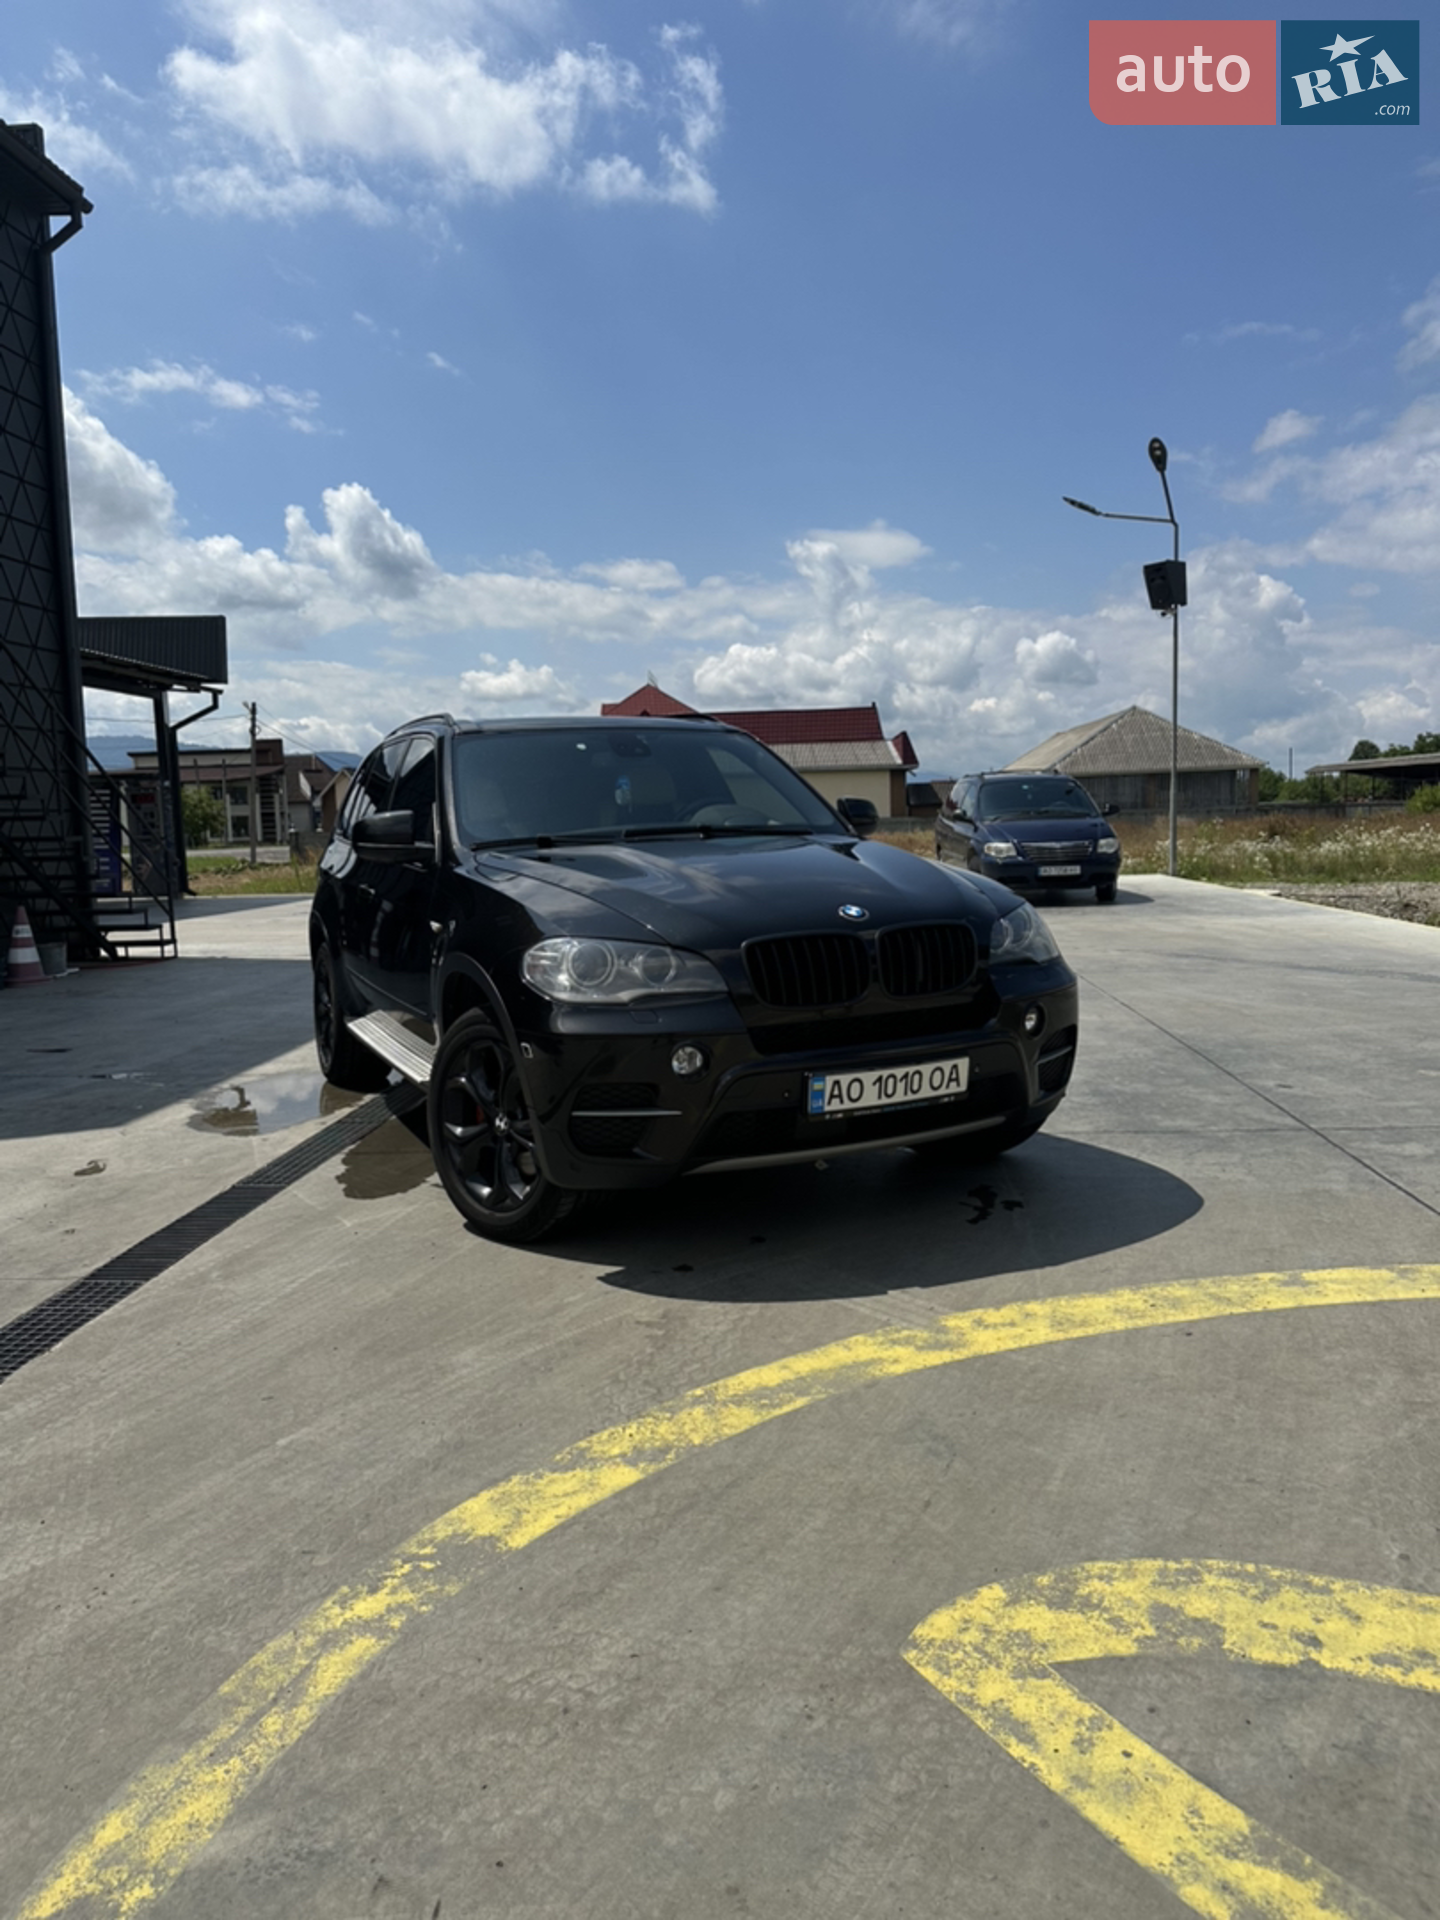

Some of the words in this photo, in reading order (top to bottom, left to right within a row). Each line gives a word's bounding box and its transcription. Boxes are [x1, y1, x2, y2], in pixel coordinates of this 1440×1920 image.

[827, 1078, 864, 1106] AO
[872, 1070, 923, 1100] 1010
[929, 1064, 961, 1091] OA
